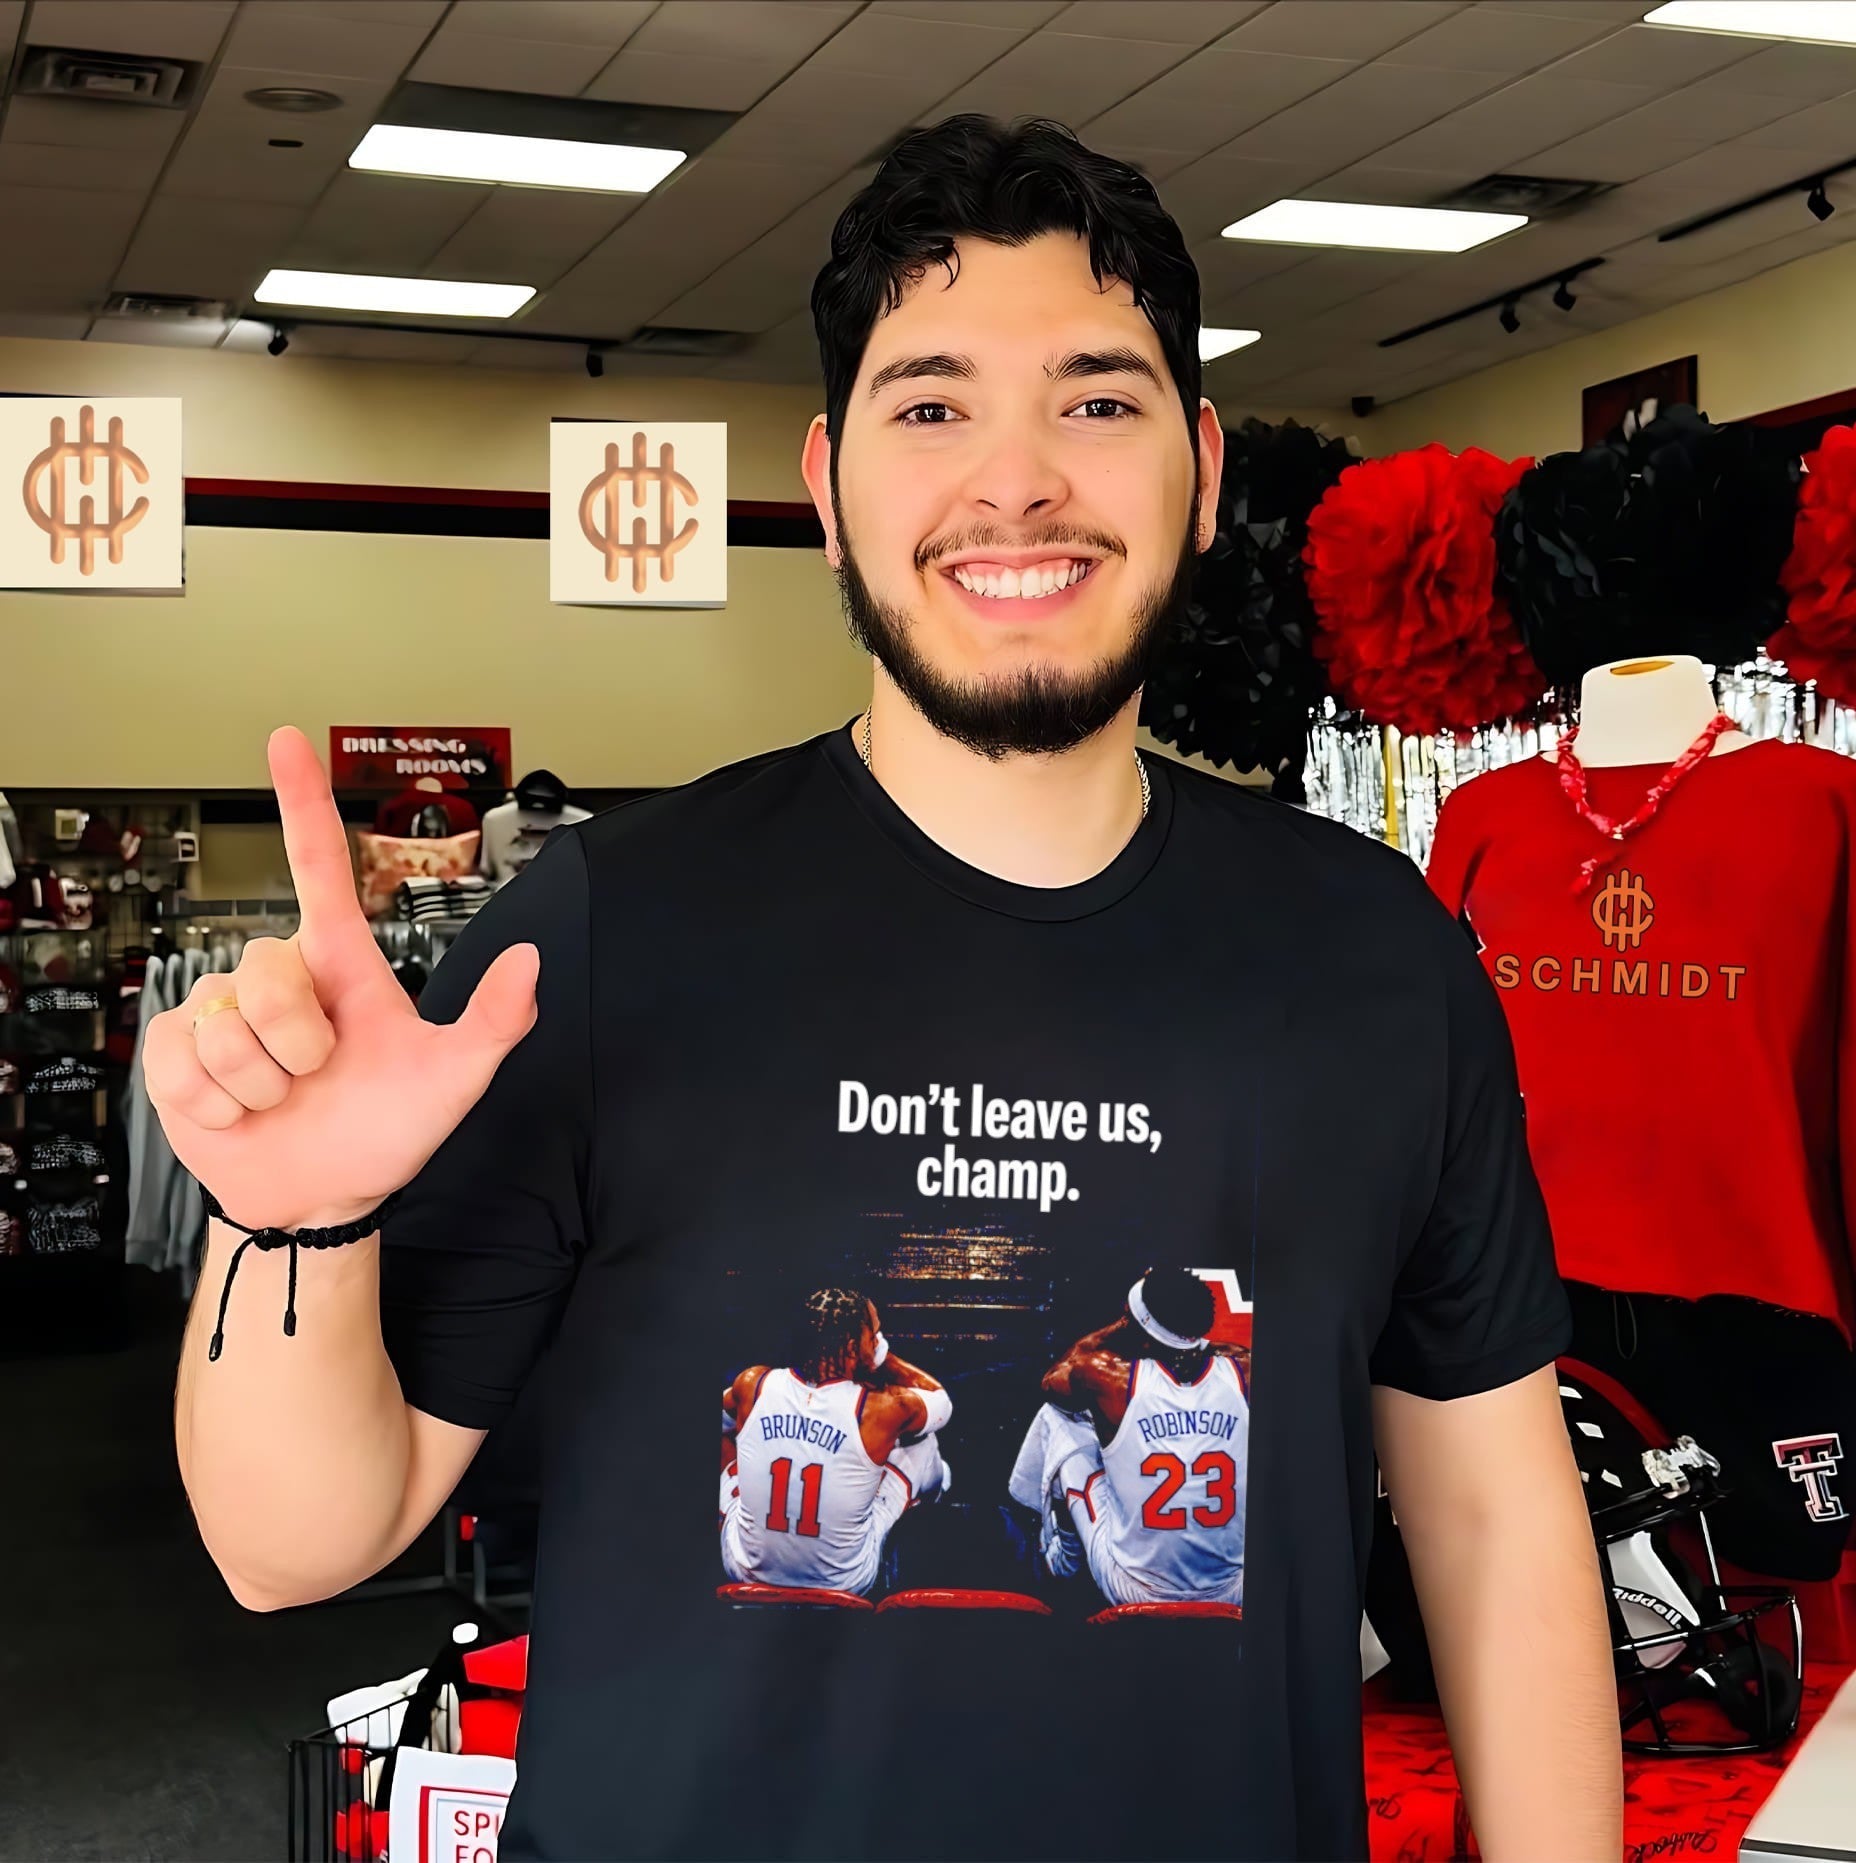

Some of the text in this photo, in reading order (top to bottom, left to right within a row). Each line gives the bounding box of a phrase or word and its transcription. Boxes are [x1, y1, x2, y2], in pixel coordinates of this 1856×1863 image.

[396, 758, 487, 775] ROOMS
[1494, 954, 1747, 1000] SCHMIDT
[838, 1080, 1162, 1154] Don’t leave us,
[917, 1143, 1080, 1213] champ.
[760, 1413, 847, 1455] BRUNSON
[1137, 1410, 1239, 1443] ROBINSON
[766, 1456, 824, 1538] 11
[1140, 1450, 1236, 1530] 23
